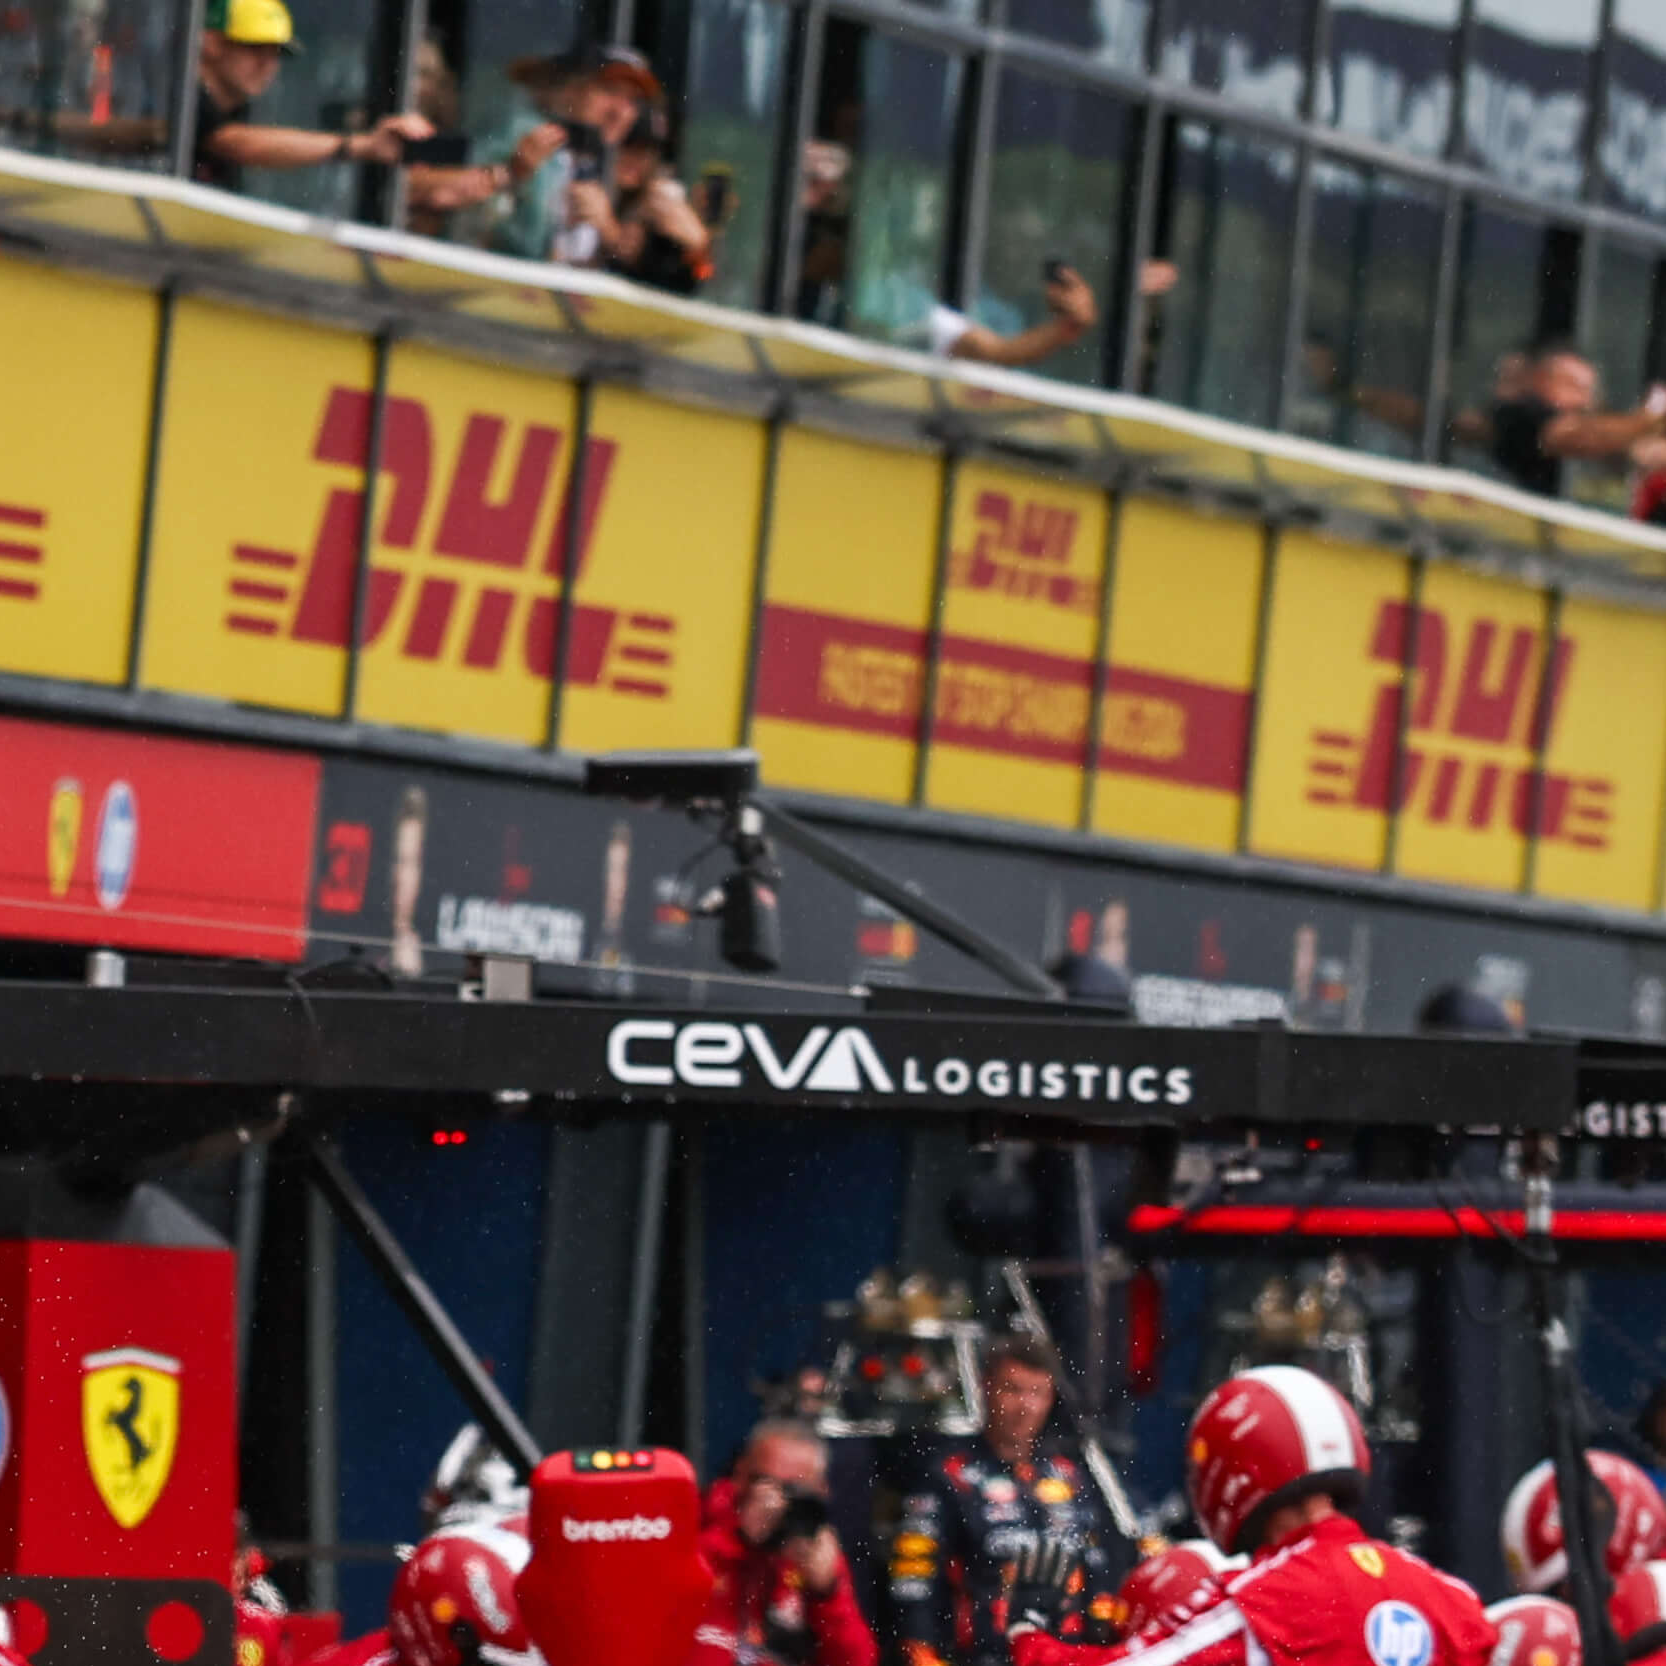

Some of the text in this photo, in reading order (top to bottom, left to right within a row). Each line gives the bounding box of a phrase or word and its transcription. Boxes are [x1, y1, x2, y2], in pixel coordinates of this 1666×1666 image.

[290, 386, 620, 688] DHL
[1353, 598, 1574, 840] DHL
[904, 1059, 1192, 1104] LOGISTICS
[562, 1515, 671, 1542] brembo
